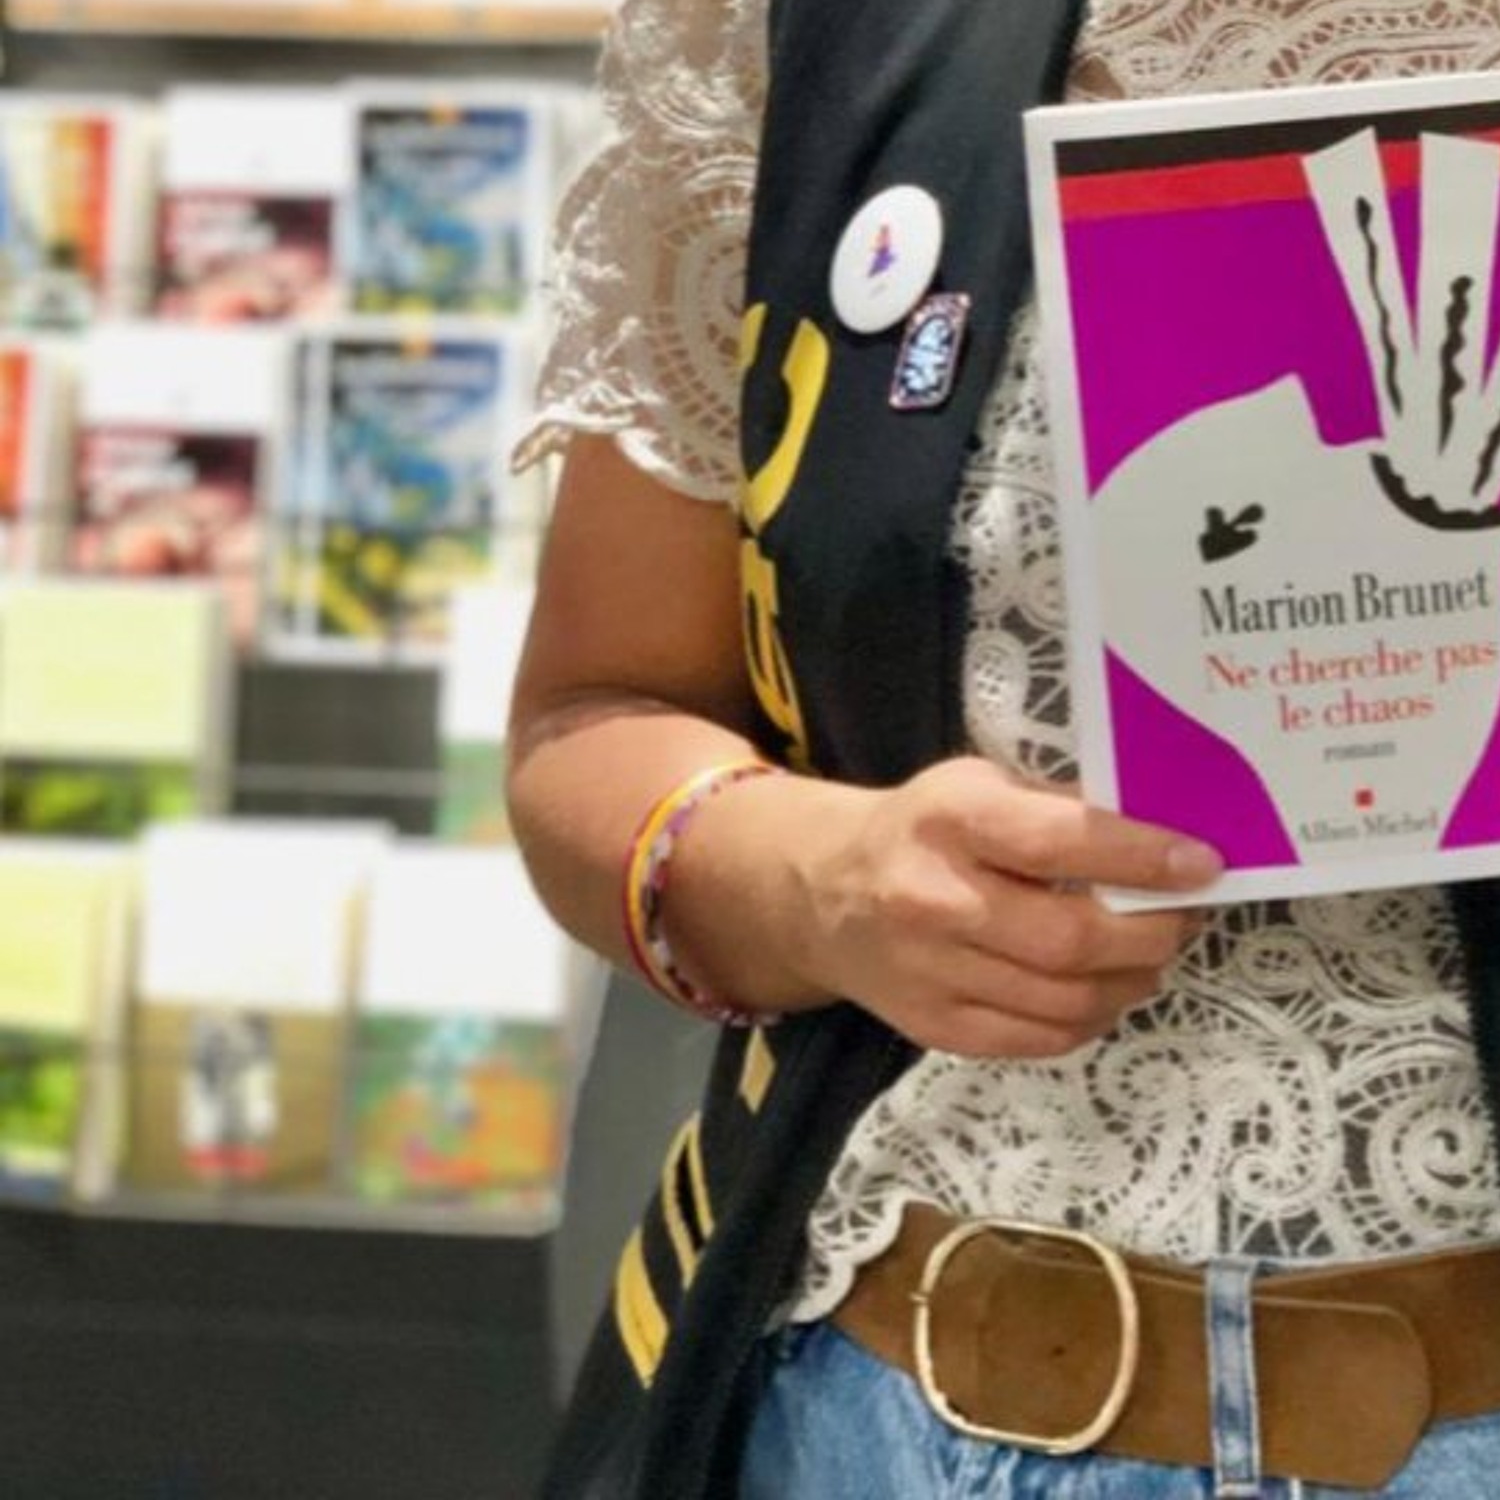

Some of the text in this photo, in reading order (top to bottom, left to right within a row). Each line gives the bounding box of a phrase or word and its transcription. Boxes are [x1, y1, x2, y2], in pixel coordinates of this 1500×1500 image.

[1200, 567, 1490, 637] Marion Brunet
[1204, 638, 1498, 692] Ne cherche pas
[1278, 687, 1436, 733] le chaos
